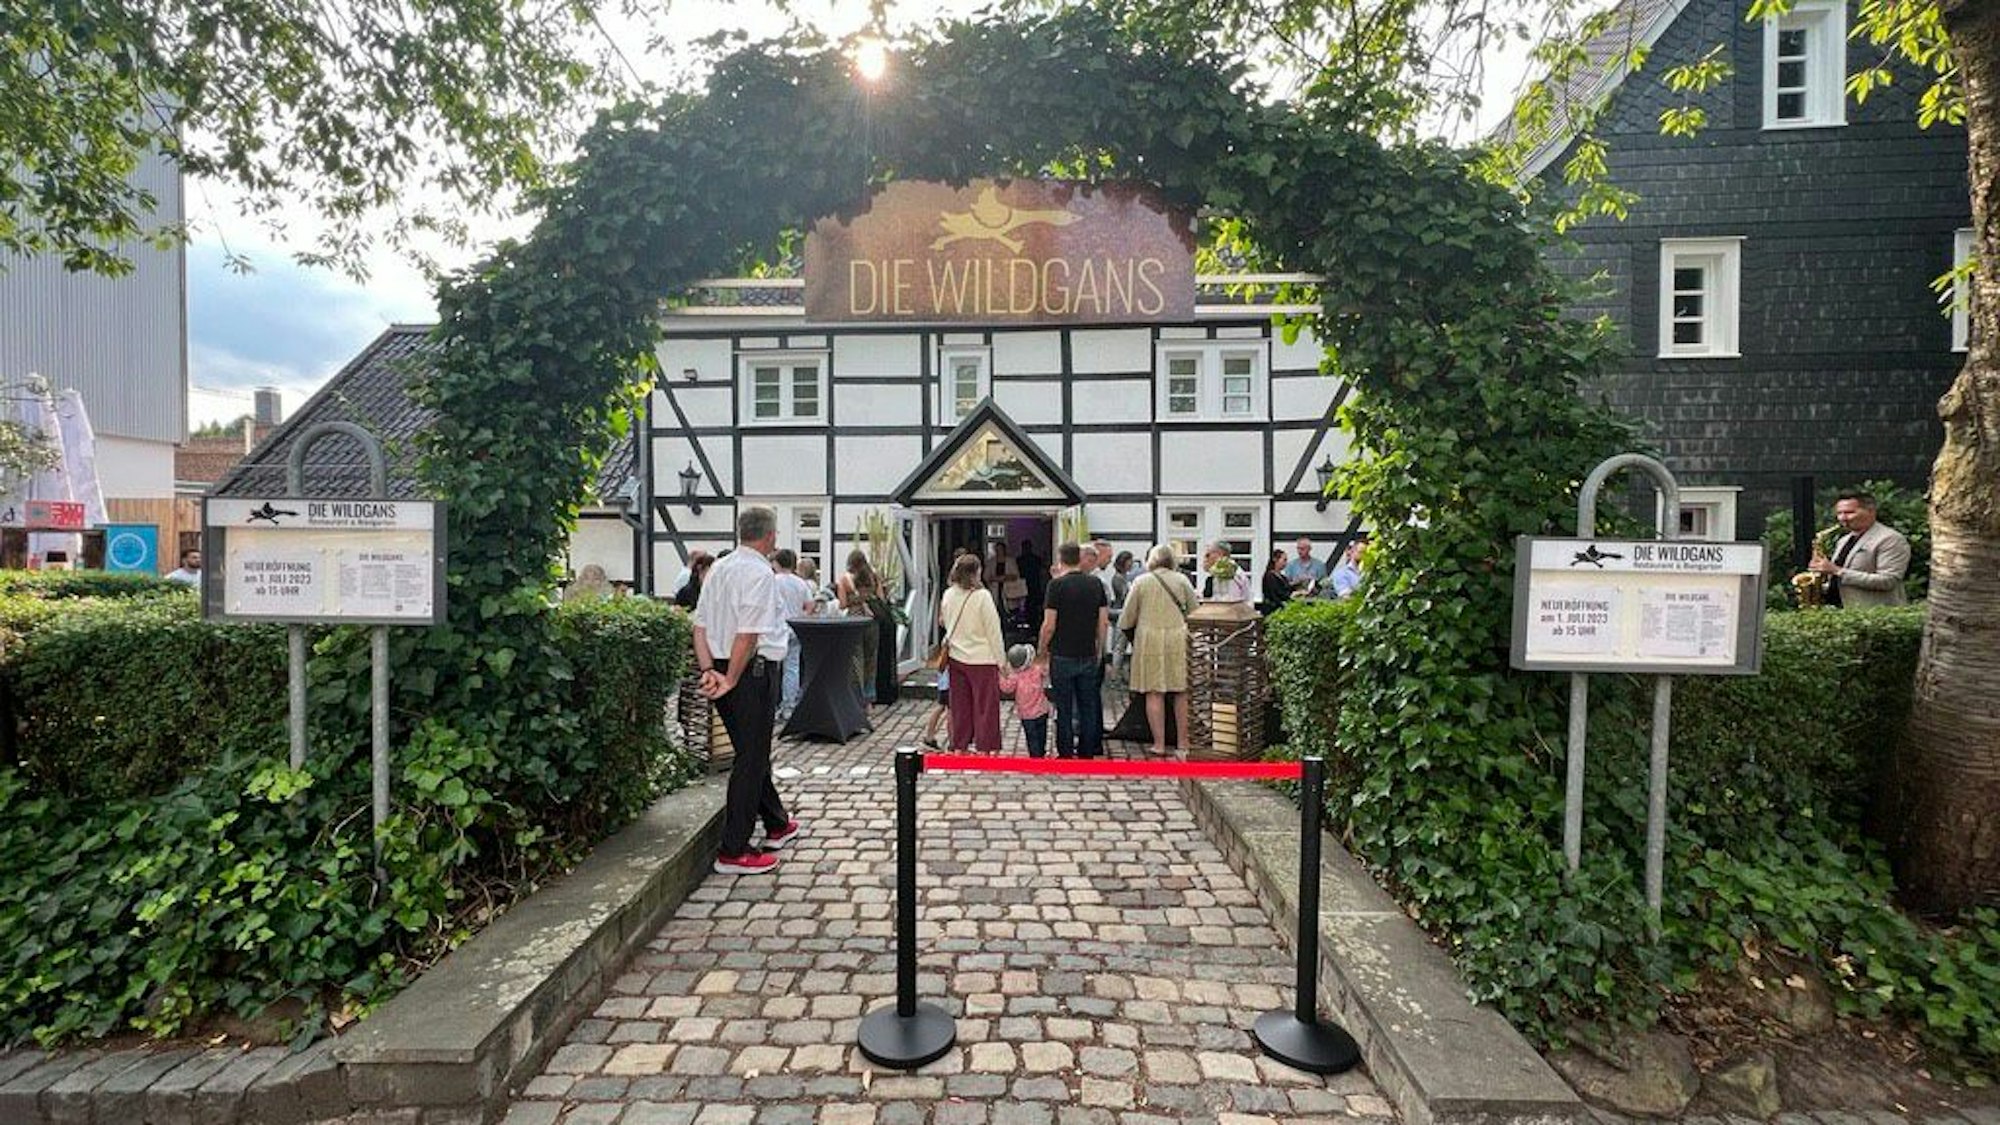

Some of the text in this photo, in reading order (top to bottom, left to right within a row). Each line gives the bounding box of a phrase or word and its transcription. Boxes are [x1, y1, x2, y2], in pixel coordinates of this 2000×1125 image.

[849, 257, 1165, 316] DIE WILDGANS
[308, 503, 396, 519] DIE WILDGANS
[1634, 545, 1724, 563] DIE WILDGANS
[244, 560, 311, 572] NEUERÖFFNUNG
[244, 574, 311, 585] am 1. JULI 2023
[255, 586, 299, 596] ab 15 UHR
[1541, 599, 1609, 611] NEUERÖFFNUNG
[1541, 613, 1608, 624] am 1. JULI 2023
[1552, 625, 1597, 636] ab 15 UHR
